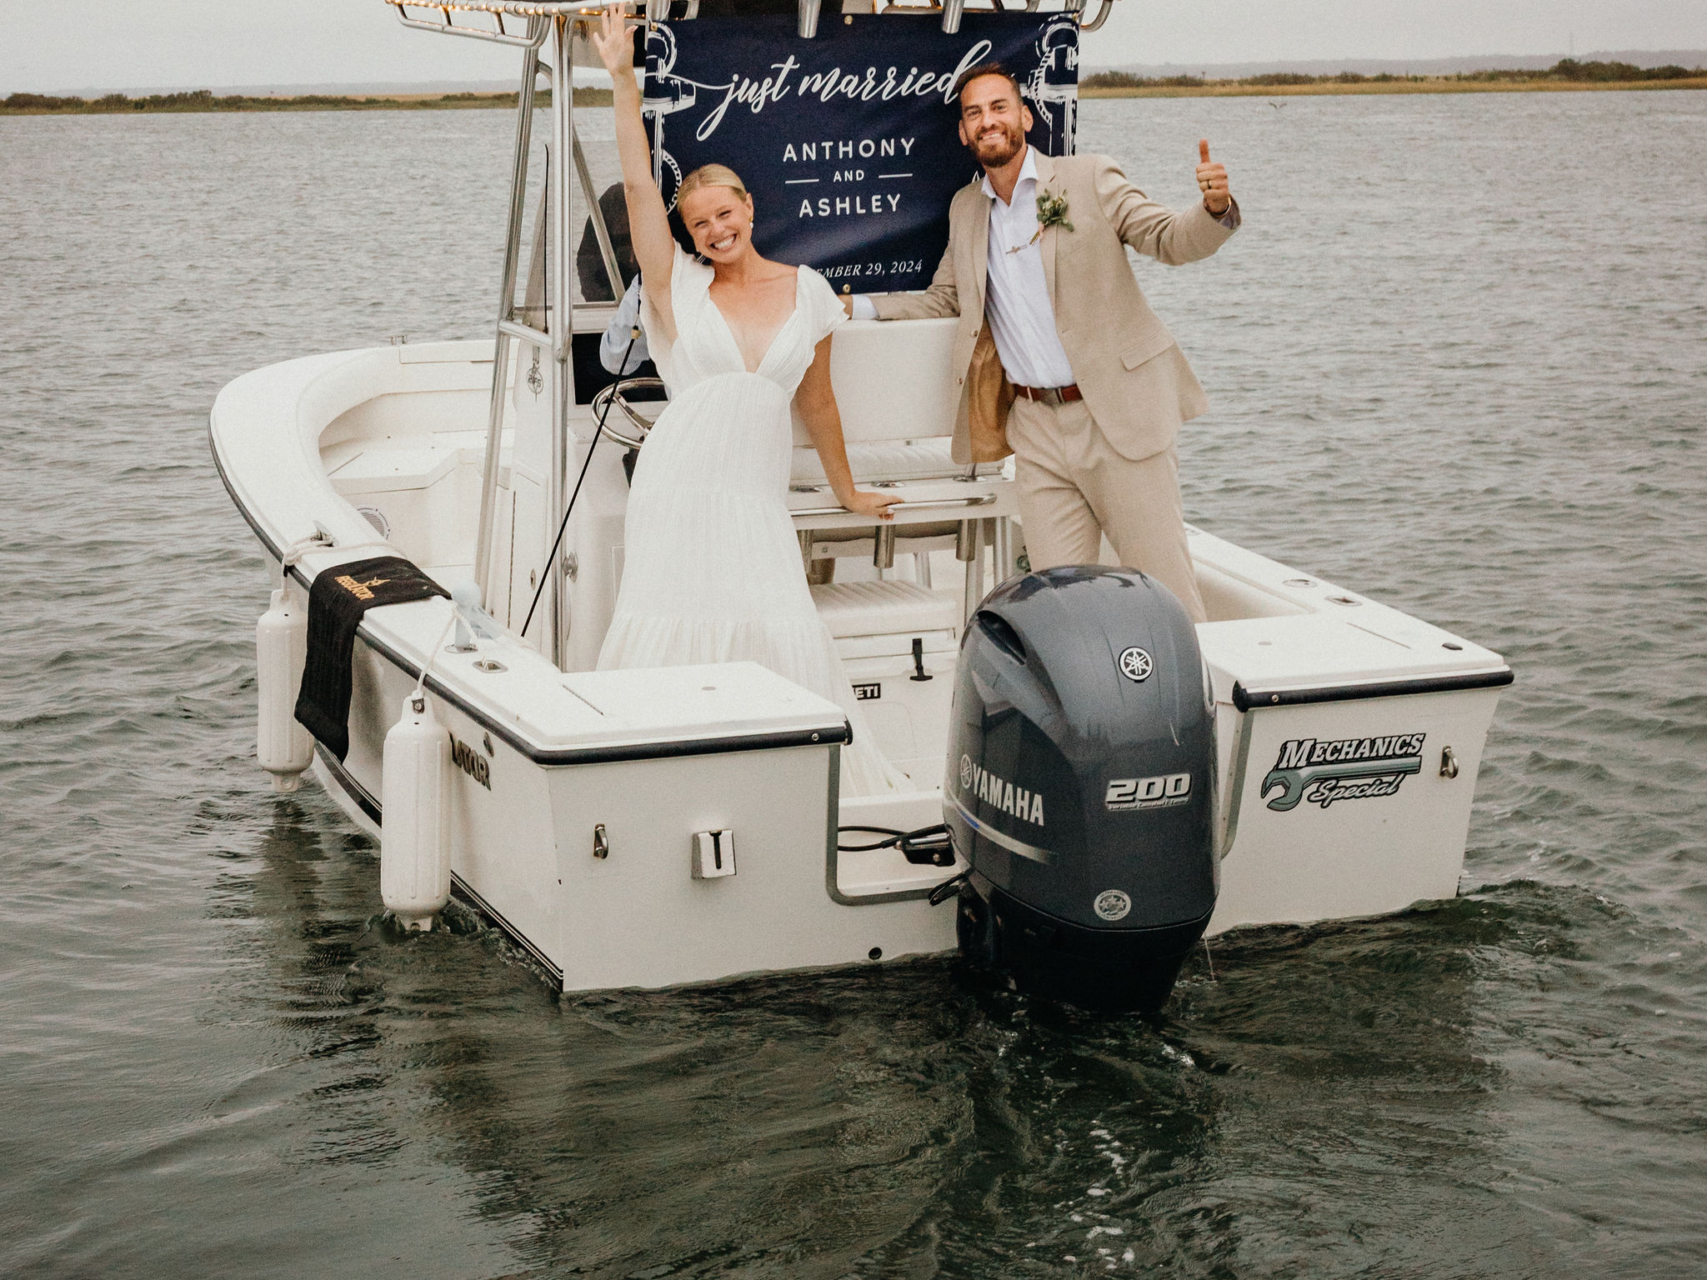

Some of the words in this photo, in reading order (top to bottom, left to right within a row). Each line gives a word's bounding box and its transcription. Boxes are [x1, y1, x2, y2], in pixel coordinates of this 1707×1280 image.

[696, 54, 800, 141] just
[798, 39, 992, 104] married
[782, 137, 915, 163] ANTHONY
[832, 169, 866, 183] AND
[798, 193, 901, 218] ASHLEY
[865, 262, 885, 276] 29,
[890, 258, 923, 274] 2024
[854, 685, 879, 699] ETI
[1279, 733, 1427, 769] MECHANICS
[973, 762, 1045, 827] YAMAHA
[1106, 774, 1191, 802] 200
[1307, 773, 1408, 809] Special
